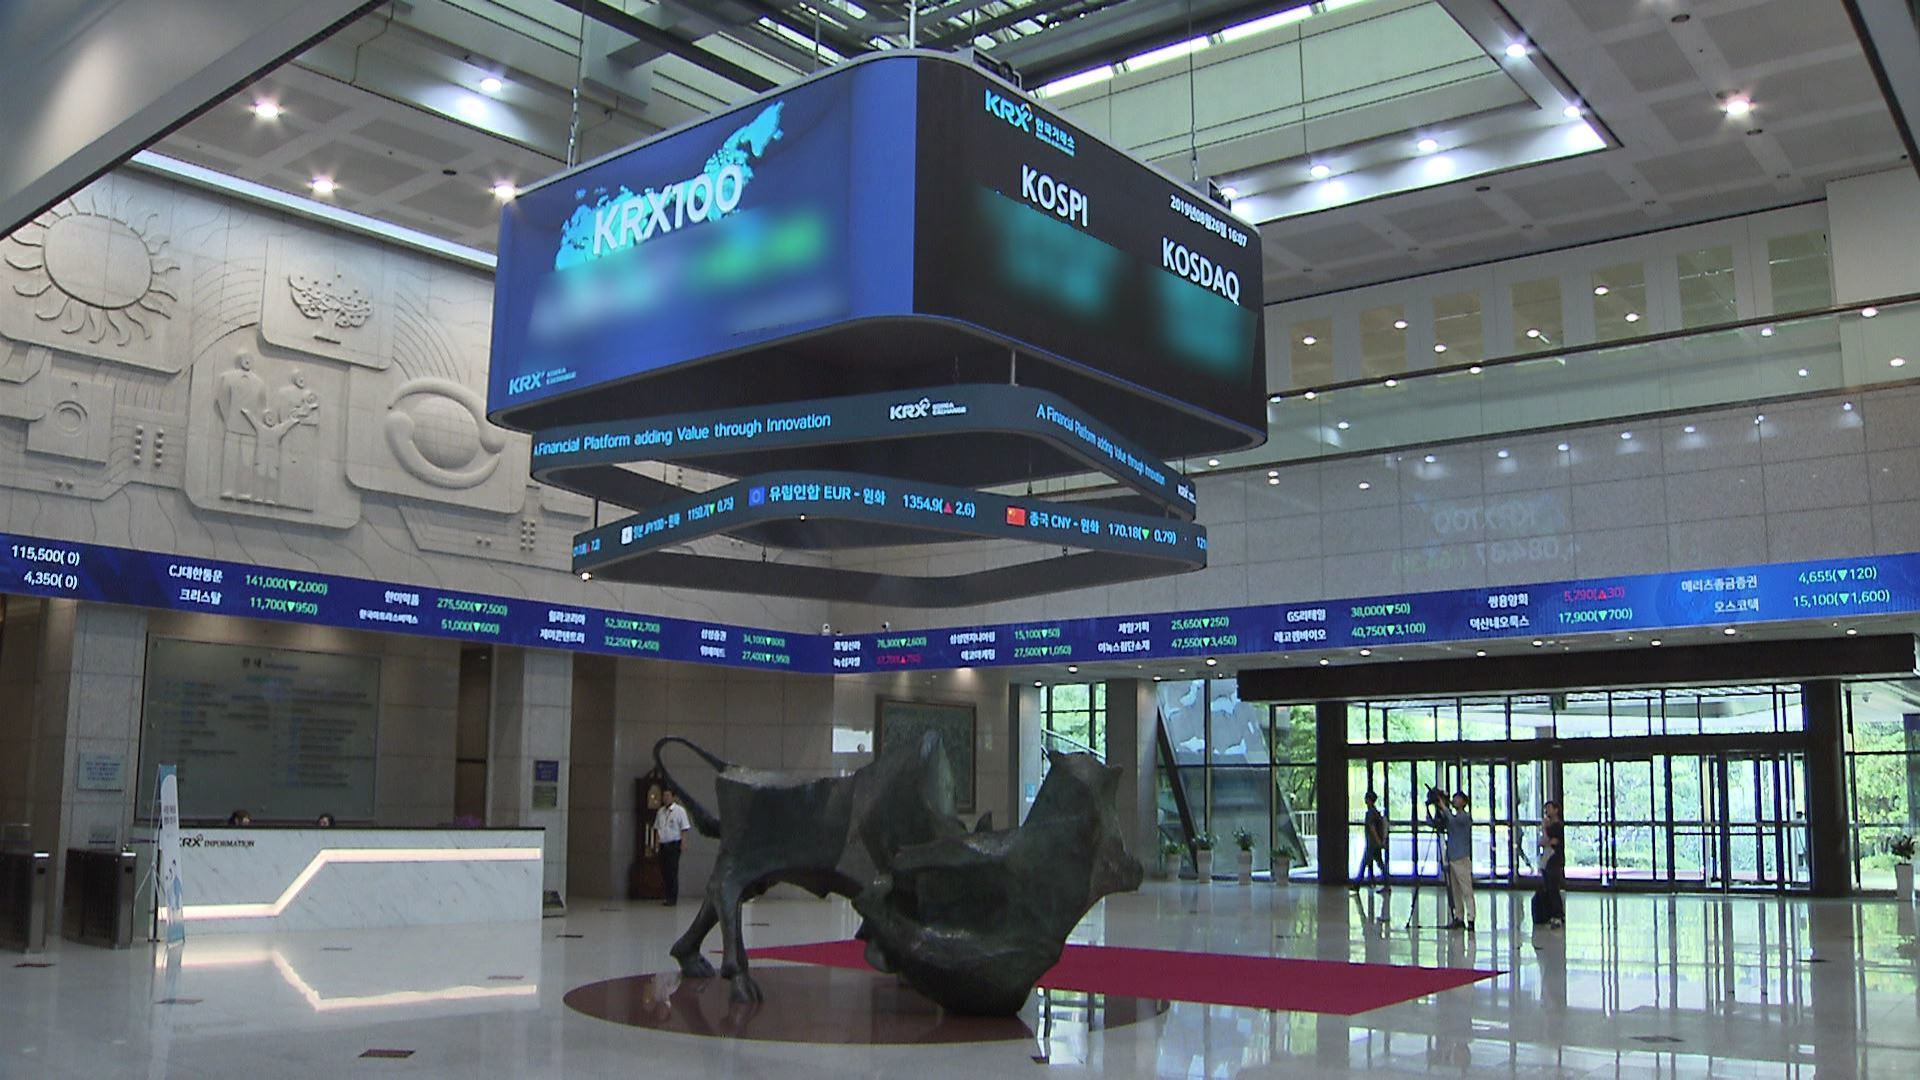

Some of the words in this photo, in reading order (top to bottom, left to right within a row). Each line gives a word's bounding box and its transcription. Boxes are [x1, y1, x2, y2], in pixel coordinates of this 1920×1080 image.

[984, 88, 1031, 133] KRX
[1021, 163, 1089, 227] KOSPI
[592, 164, 744, 256] KRX100
[1161, 237, 1240, 307] KOSDAQ
[508, 371, 544, 396] KRX
[889, 400, 929, 420] KRX
[1036, 403, 1046, 420] A
[538, 437, 580, 455] Financial
[583, 433, 630, 451] Platform
[634, 427, 673, 446] adding
[677, 425, 710, 442] Value
[714, 420, 763, 440] through
[766, 412, 832, 432] Innovation
[769, 485, 820, 502] 유럽연합
[824, 485, 851, 501] EUR
[863, 489, 886, 507] 원화
[1029, 511, 1048, 529] 중국
[1051, 514, 1071, 529] CNY
[1080, 518, 1100, 534] 원화
[168, 564, 223, 584] CJ대한통운
[179, 588, 222, 606] 크리스탈
[1487, 593, 1529, 609] 쌍용양회
[1714, 597, 1759, 613] 오스코텍
[1287, 609, 1326, 622] GS리테일
[1118, 621, 1150, 634] 제일기획
[204, 839, 255, 848] INFORMATION
